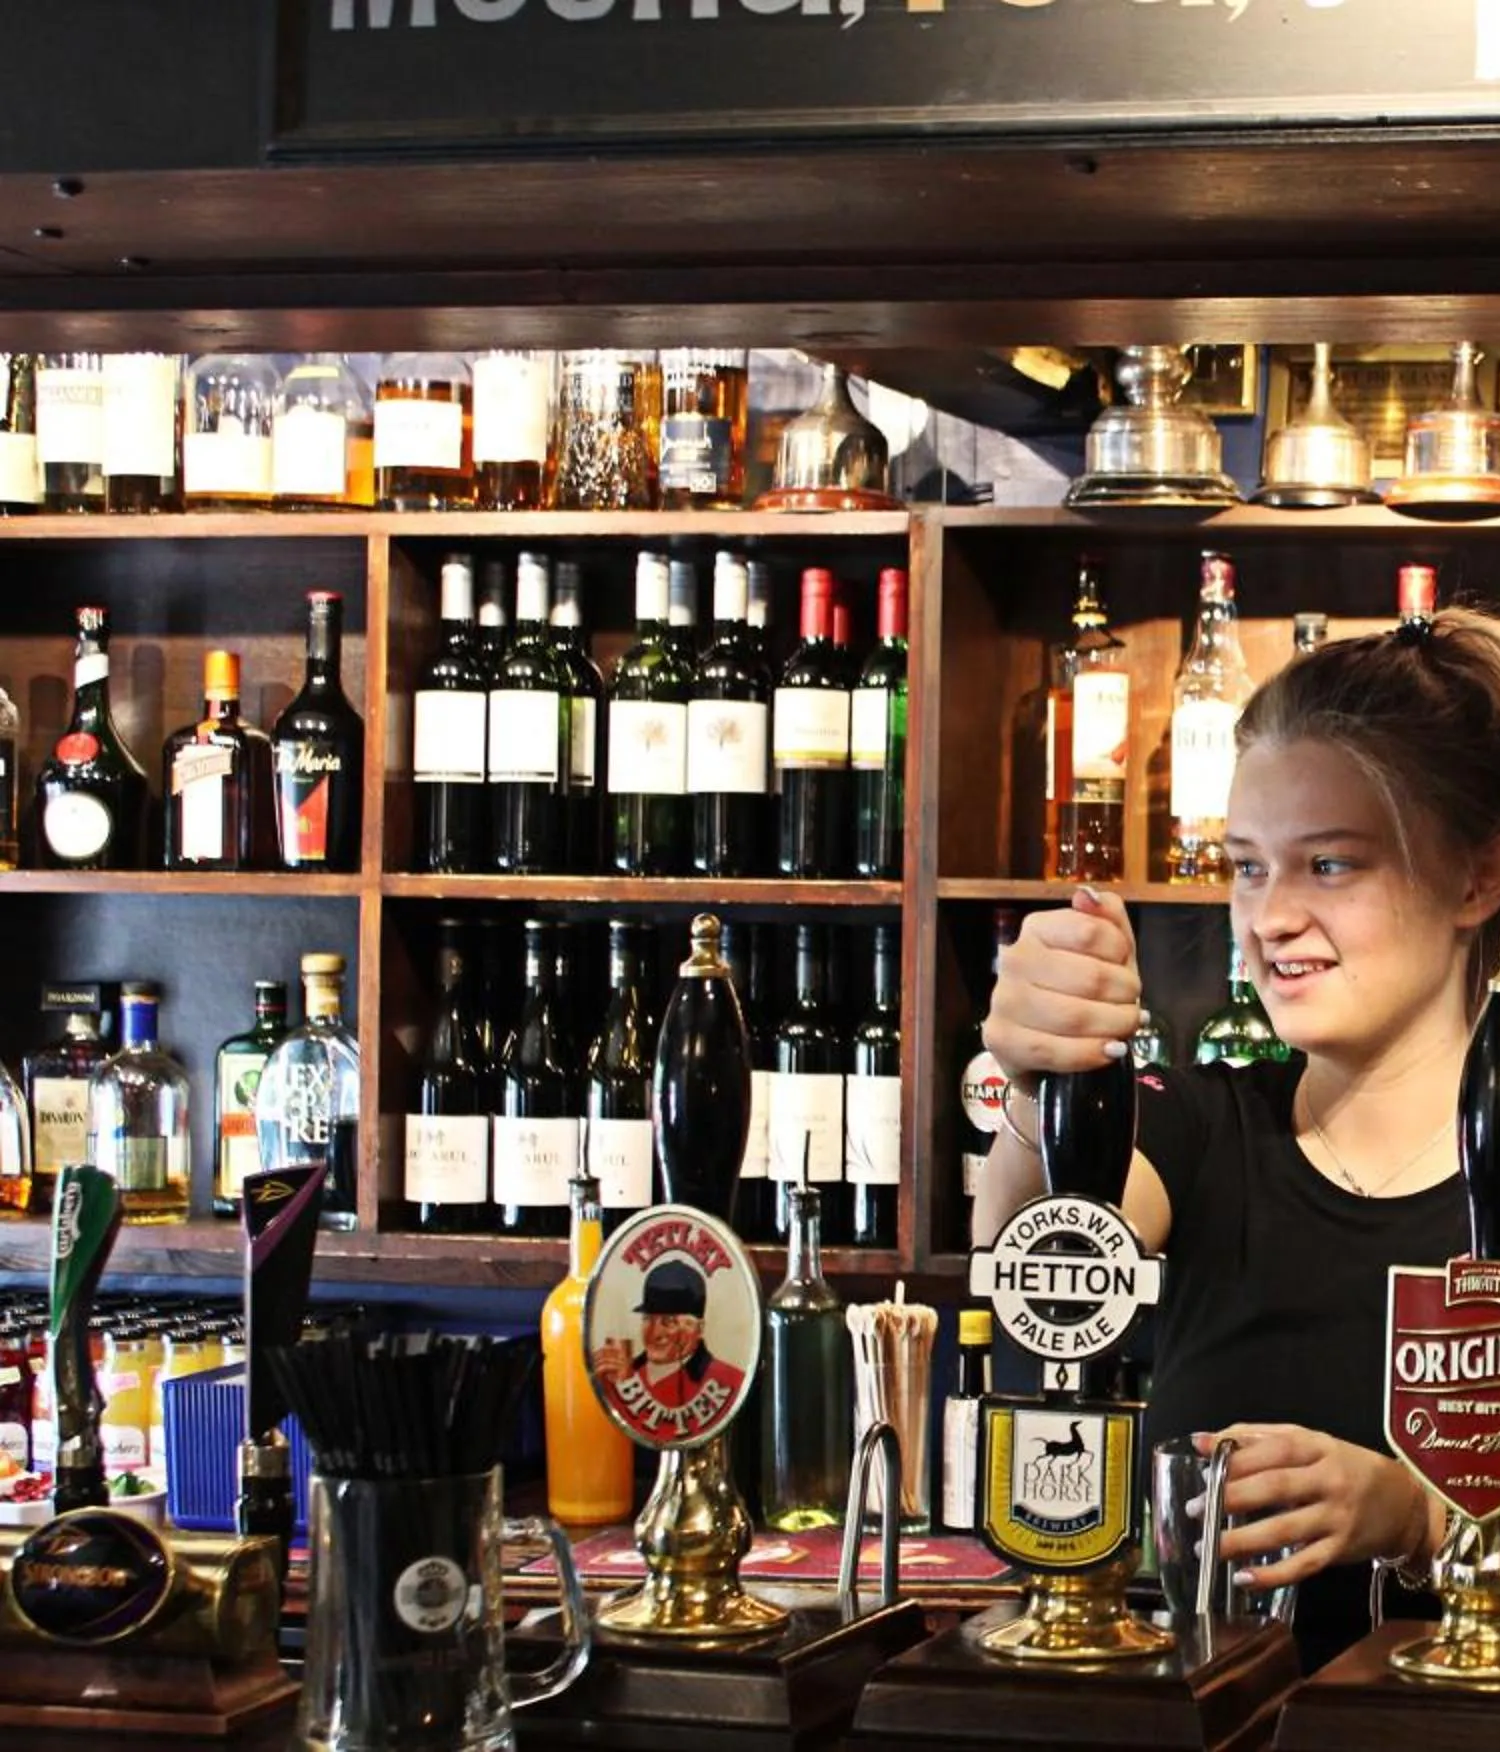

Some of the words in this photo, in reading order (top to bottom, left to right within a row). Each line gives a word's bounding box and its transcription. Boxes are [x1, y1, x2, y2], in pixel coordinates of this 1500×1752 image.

[621, 1219, 733, 1279] TETLEY
[1004, 1205, 1125, 1259] YORKS.W.R.
[993, 1260, 1136, 1297] HETTON
[1011, 1311, 1066, 1352] PALE
[1072, 1315, 1116, 1351] ALE
[615, 1372, 733, 1436] BITTER
[1437, 1399, 1474, 1414] BEST
[1022, 1462, 1093, 1486] DARK
[1022, 1482, 1094, 1502] HORSE
[1024, 1513, 1088, 1532] BREWERY
